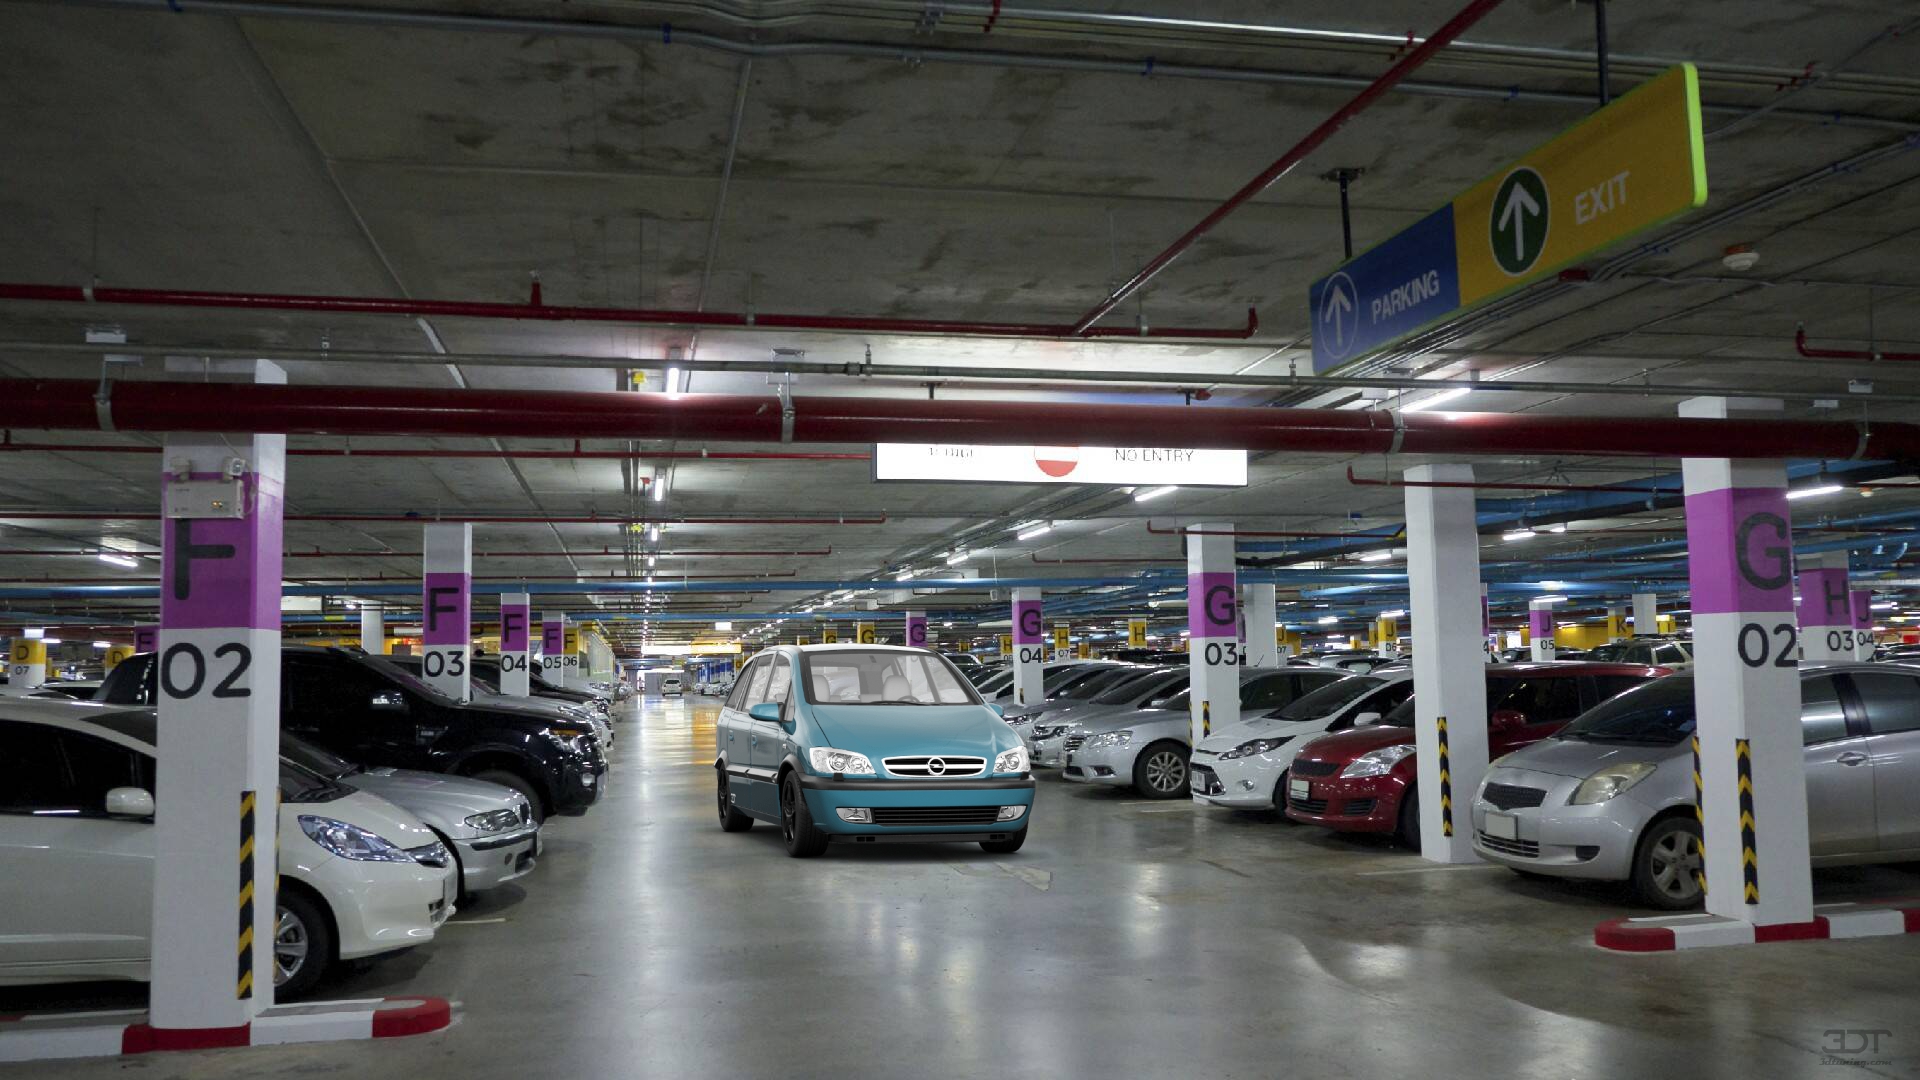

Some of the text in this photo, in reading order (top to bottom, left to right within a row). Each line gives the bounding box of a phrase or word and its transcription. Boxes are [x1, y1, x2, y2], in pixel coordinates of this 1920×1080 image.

[1574, 169, 1630, 225] EXIT
[1372, 269, 1440, 325] PARKING
[1115, 448, 1194, 462] NO ENTRY
[173, 519, 236, 600] F
[1735, 512, 1792, 590] G
[1204, 585, 1235, 626] G
[1824, 579, 1850, 616] H
[428, 587, 459, 632] F
[1858, 598, 1869, 622] J
[504, 613, 523, 643] F
[911, 624, 926, 643] G
[1021, 609, 1041, 637] G
[1134, 626, 1146, 642] H
[1542, 615, 1551, 632] J
[546, 628, 559, 649] F
[564, 633, 575, 649] F
[1058, 631, 1068, 644] H
[1540, 639, 1555, 650] 05
[1738, 622, 1799, 668] 02
[1826, 630, 1854, 652] 03
[1857, 631, 1874, 646] 04
[16, 645, 29, 660] D
[501, 654, 527, 673] 04
[543, 656, 562, 669] 05
[563, 656, 578, 667] 06
[1020, 648, 1043, 663] 04
[1204, 642, 1237, 666] 03
[160, 641, 252, 700] 02
[424, 650, 465, 678] 03
